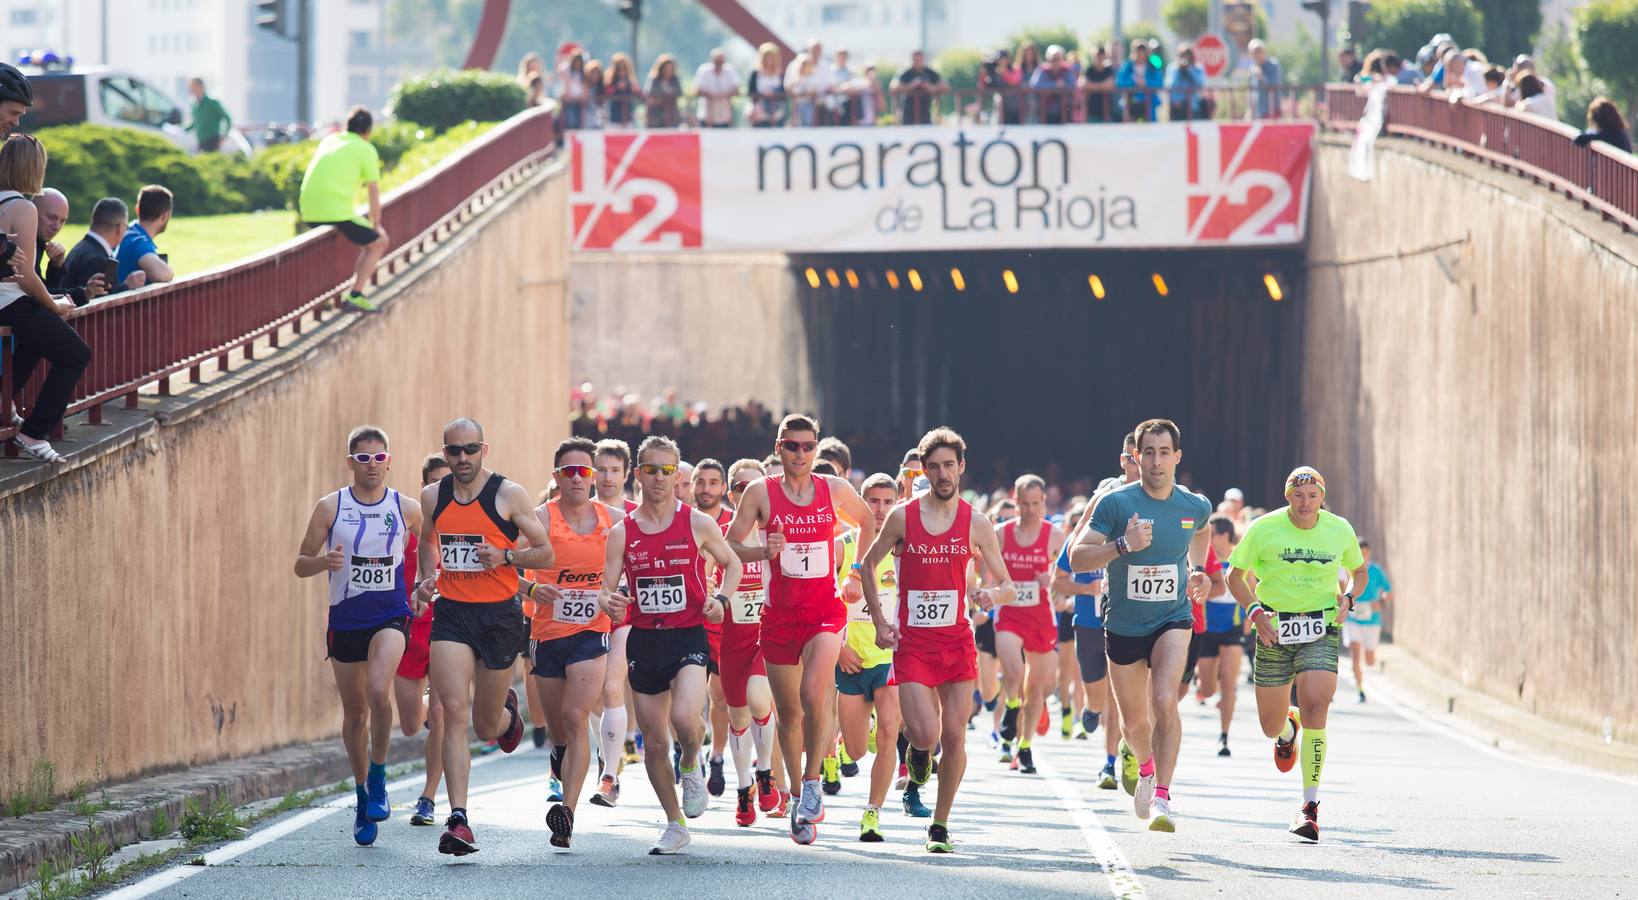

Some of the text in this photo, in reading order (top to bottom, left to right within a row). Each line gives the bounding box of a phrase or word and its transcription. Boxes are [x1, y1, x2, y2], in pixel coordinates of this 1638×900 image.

[756, 130, 1070, 191] maratón
[874, 183, 1138, 242] de La Rioja
[771, 513, 833, 525] AÑARES
[789, 527, 817, 535] RIOJA
[442, 547, 481, 564] 2173
[906, 543, 968, 554] AÑARES
[801, 556, 809, 571] 1
[922, 556, 950, 564] RIOJA
[351, 567, 392, 584] 2081
[557, 569, 603, 584] Ferrer
[1131, 578, 1175, 594] 1073
[640, 588, 683, 606] 2150
[1013, 591, 1033, 601] 24
[562, 601, 595, 618] 526
[916, 603, 950, 620] 387
[1281, 620, 1323, 638] 2016
[1311, 738, 1324, 783] Kalenji
